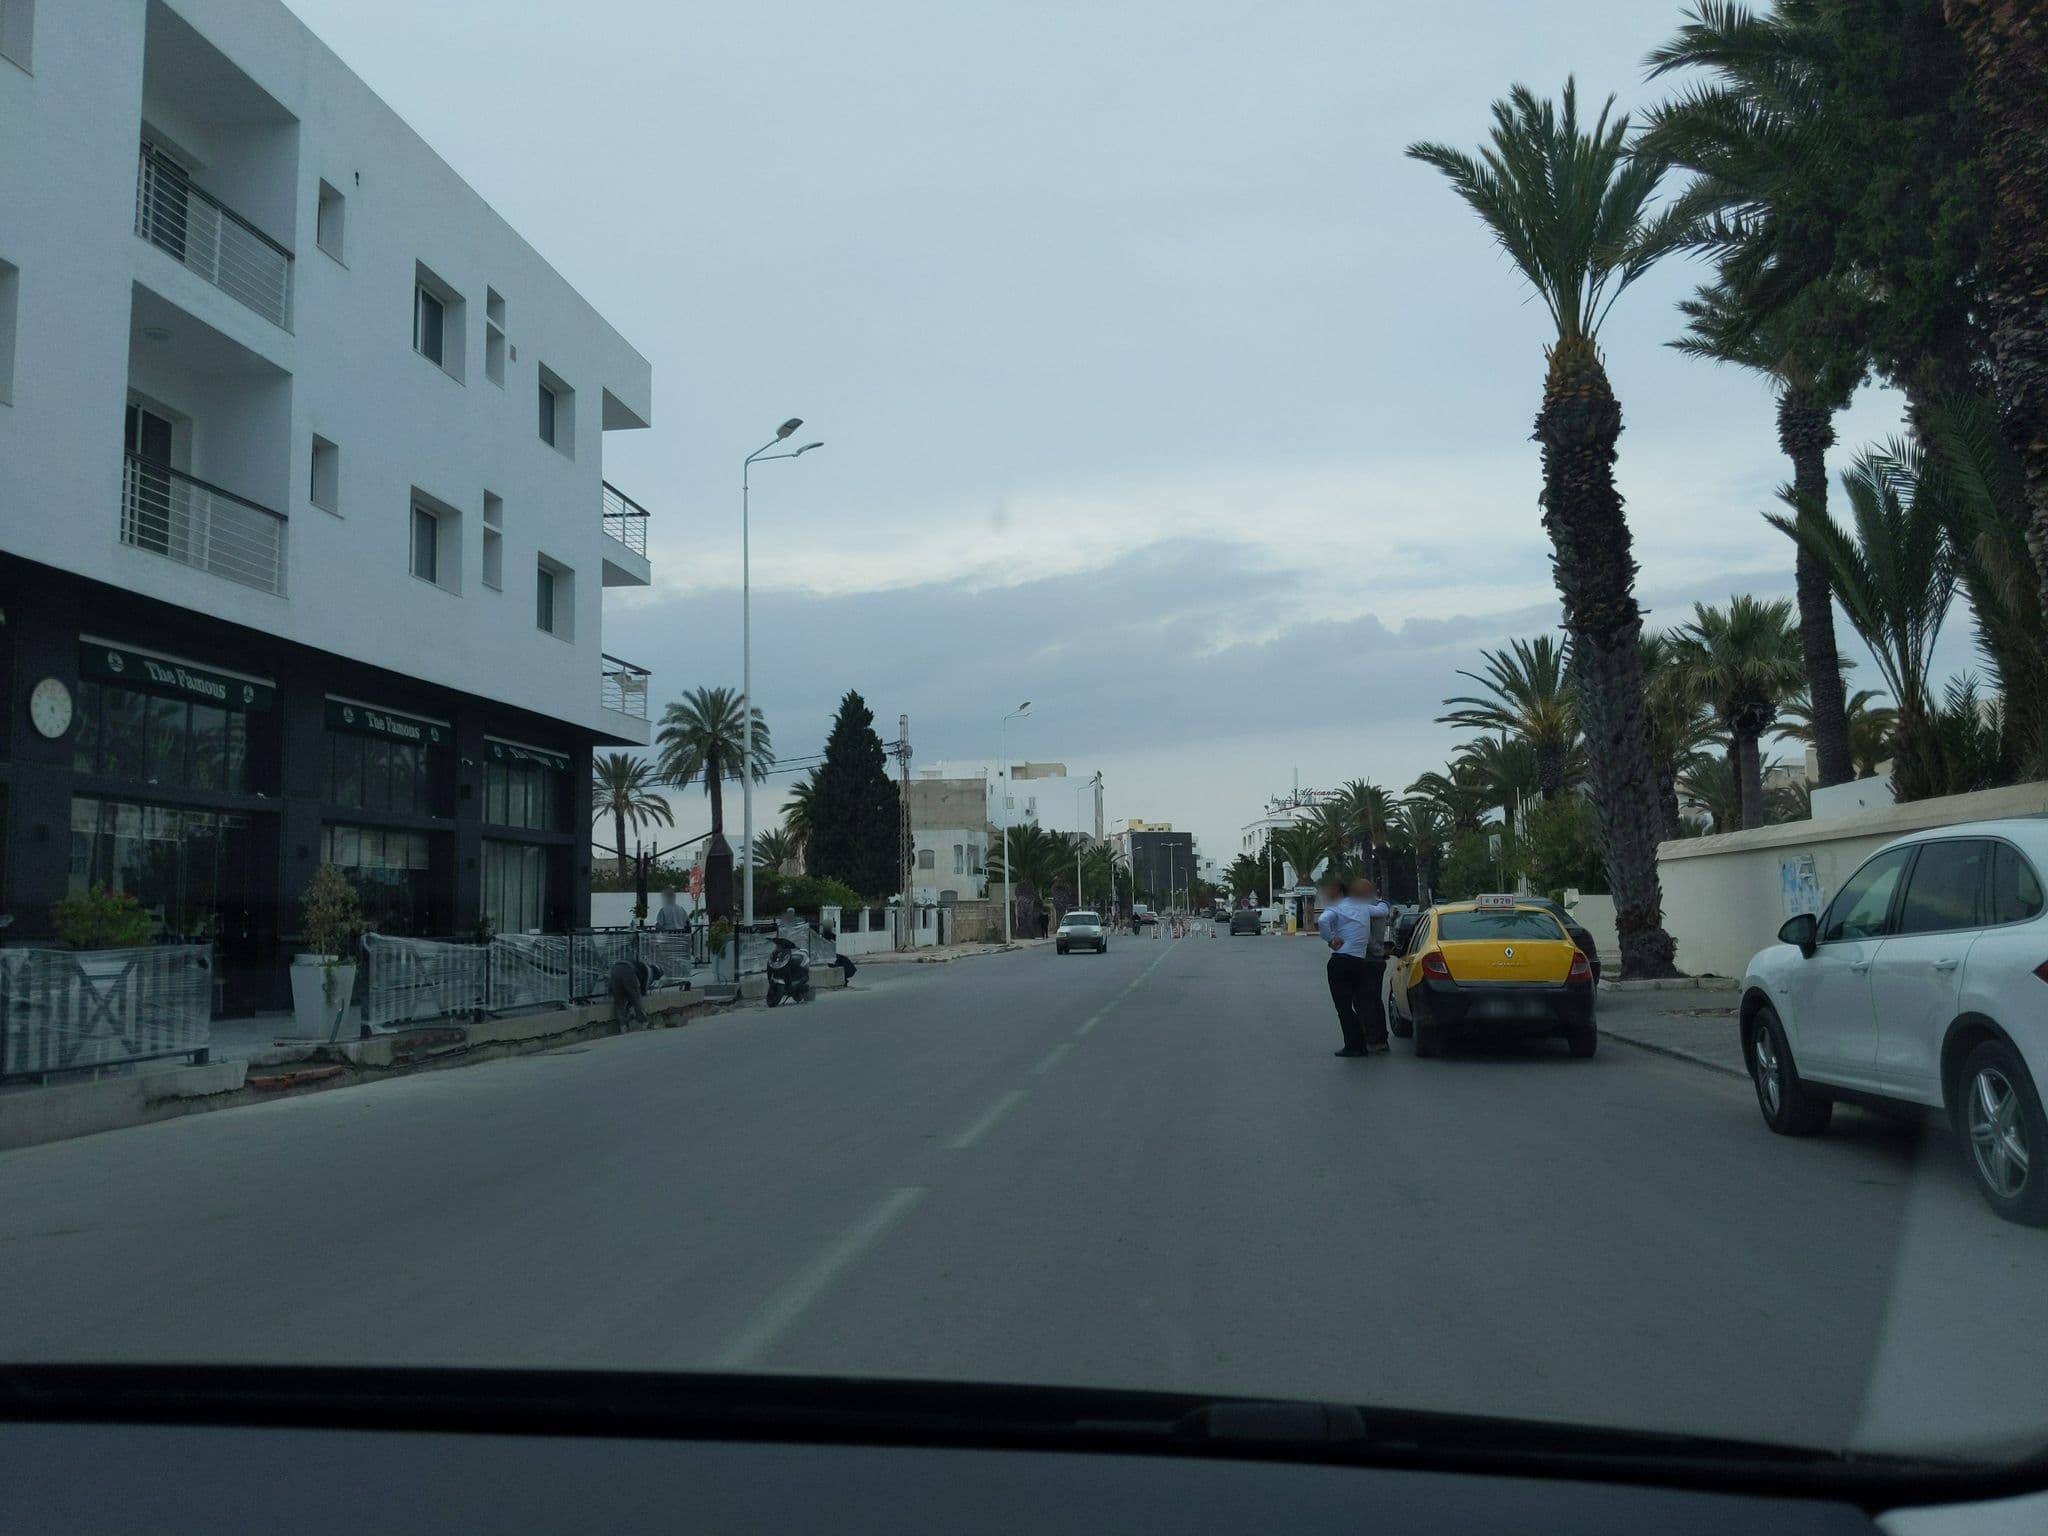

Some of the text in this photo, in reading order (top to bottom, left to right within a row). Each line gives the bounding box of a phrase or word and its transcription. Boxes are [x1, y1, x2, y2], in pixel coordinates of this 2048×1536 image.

[144, 660, 226, 699] The Famous
[364, 711, 420, 739] The Famous
